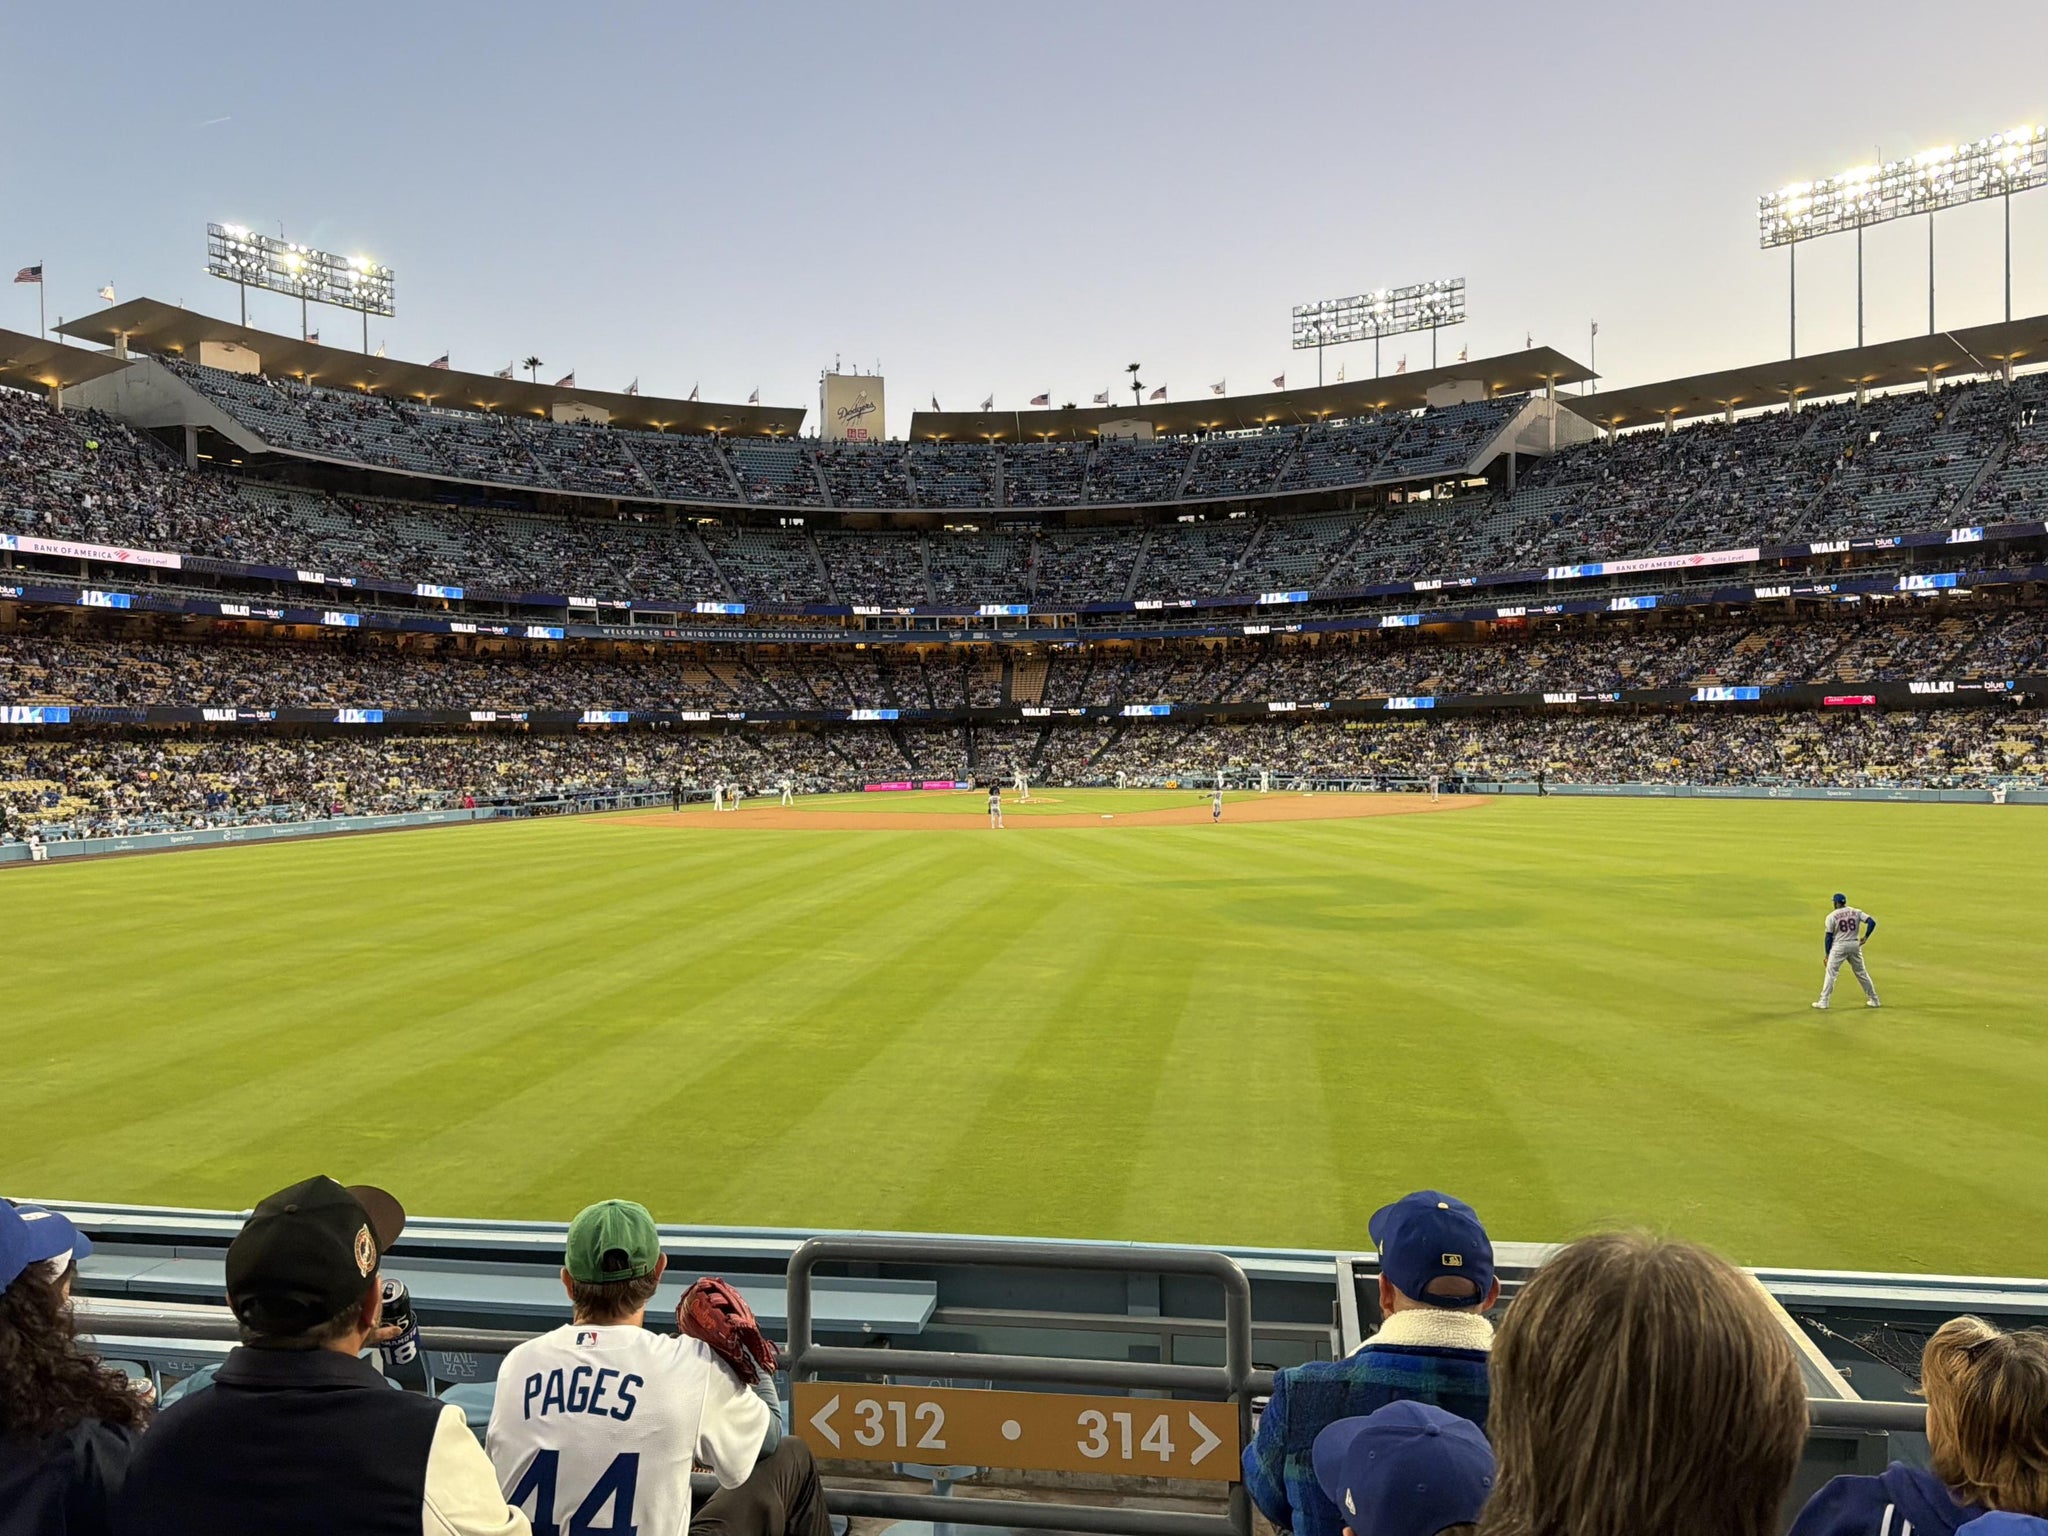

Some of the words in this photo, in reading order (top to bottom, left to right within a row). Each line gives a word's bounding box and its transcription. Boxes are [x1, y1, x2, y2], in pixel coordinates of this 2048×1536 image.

[837, 402, 876, 420] Dodgers
[34, 544, 58, 553] BANK
[74, 549, 112, 559] AMERICA
[1810, 540, 1849, 554] WALK!
[1650, 559, 1686, 568] AMERICA
[1755, 586, 1790, 598] WALK!
[1909, 681, 1954, 693] WALK!
[1839, 918, 1856, 932] 88
[382, 1340, 417, 1364] 18
[524, 1366, 644, 1422] PAGES
[854, 1399, 946, 1450] 312
[1077, 1409, 1175, 1462] 314
[505, 1449, 641, 1536] 44
